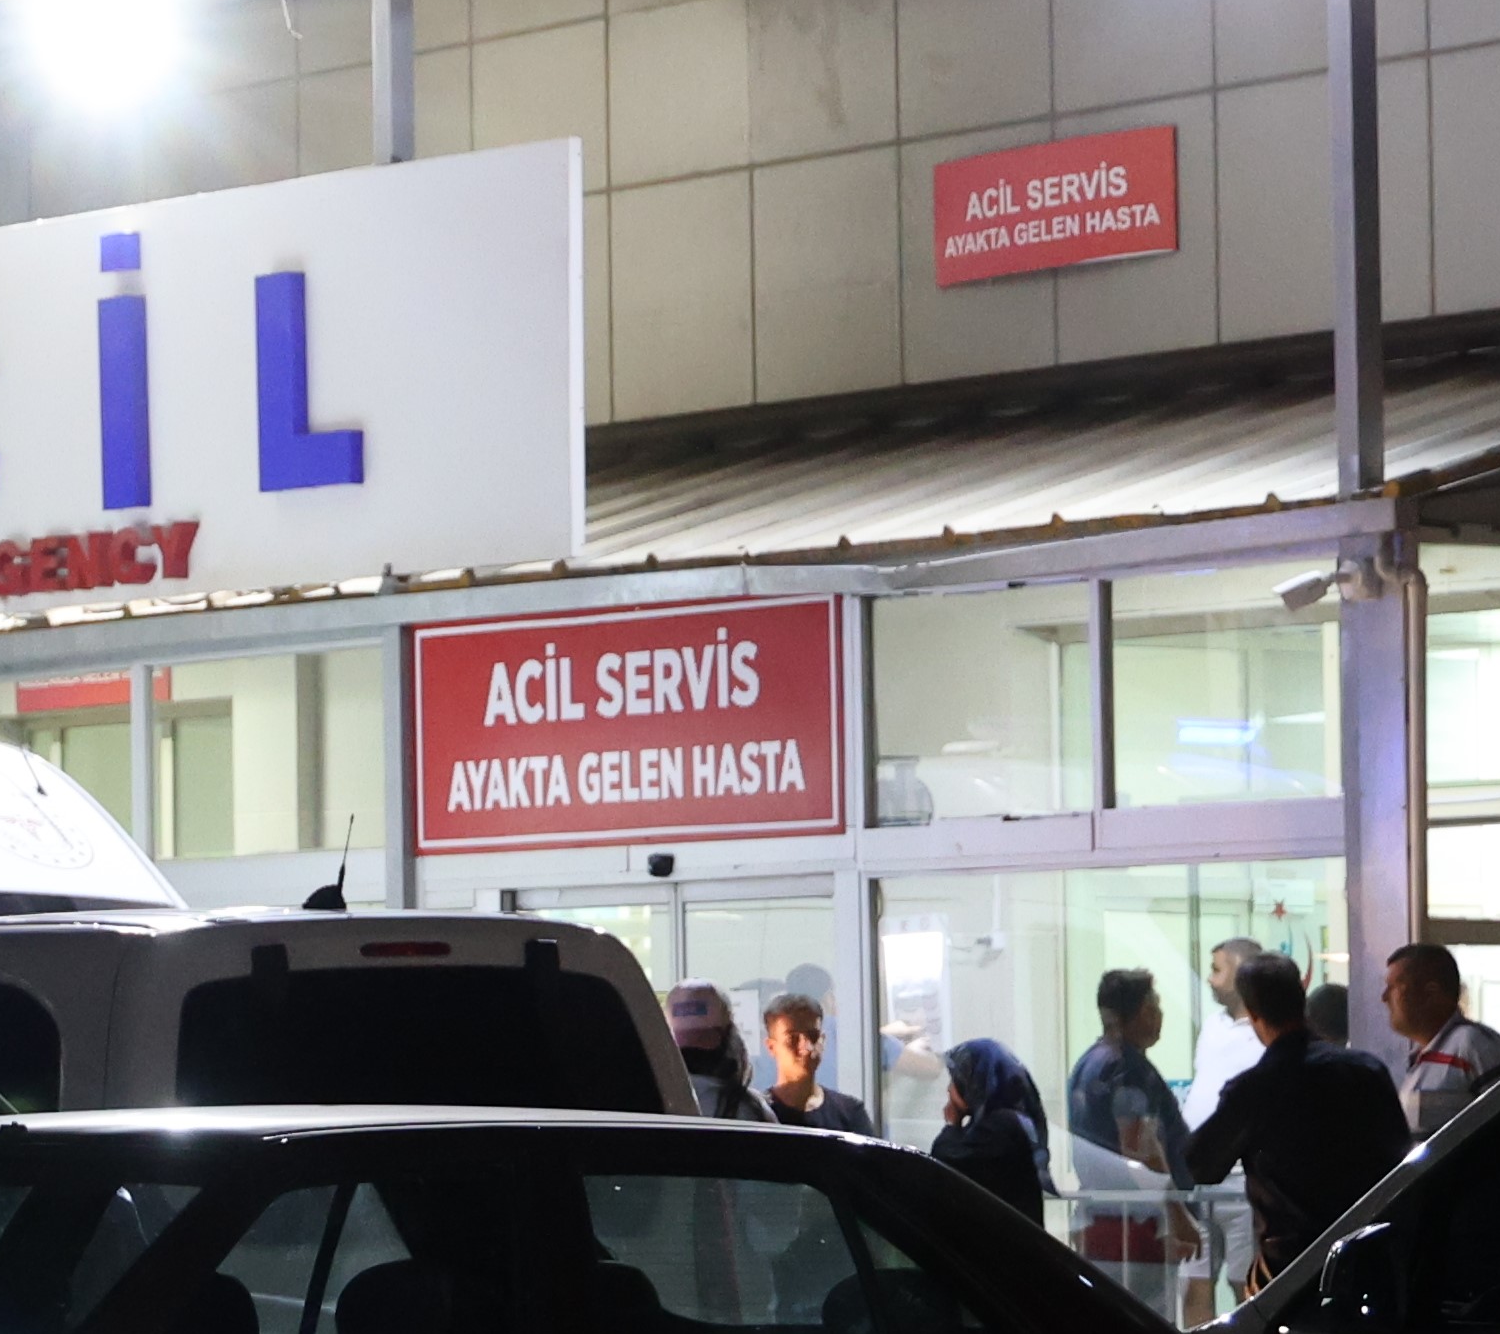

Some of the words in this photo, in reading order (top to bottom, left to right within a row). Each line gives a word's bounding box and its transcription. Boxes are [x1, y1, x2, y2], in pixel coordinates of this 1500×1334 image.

[965, 178, 1021, 222] ACİL
[1026, 161, 1129, 211] SERVİS
[944, 225, 1011, 259] AYAKTA
[1013, 214, 1081, 247] GELEN
[1085, 202, 1161, 234] HASTA
[483, 643, 585, 727] ACİL
[595, 627, 761, 719] SERVİS
[447, 754, 571, 813] AYAKTA
[577, 746, 684, 805] GELEN
[692, 738, 805, 797] HASTA
